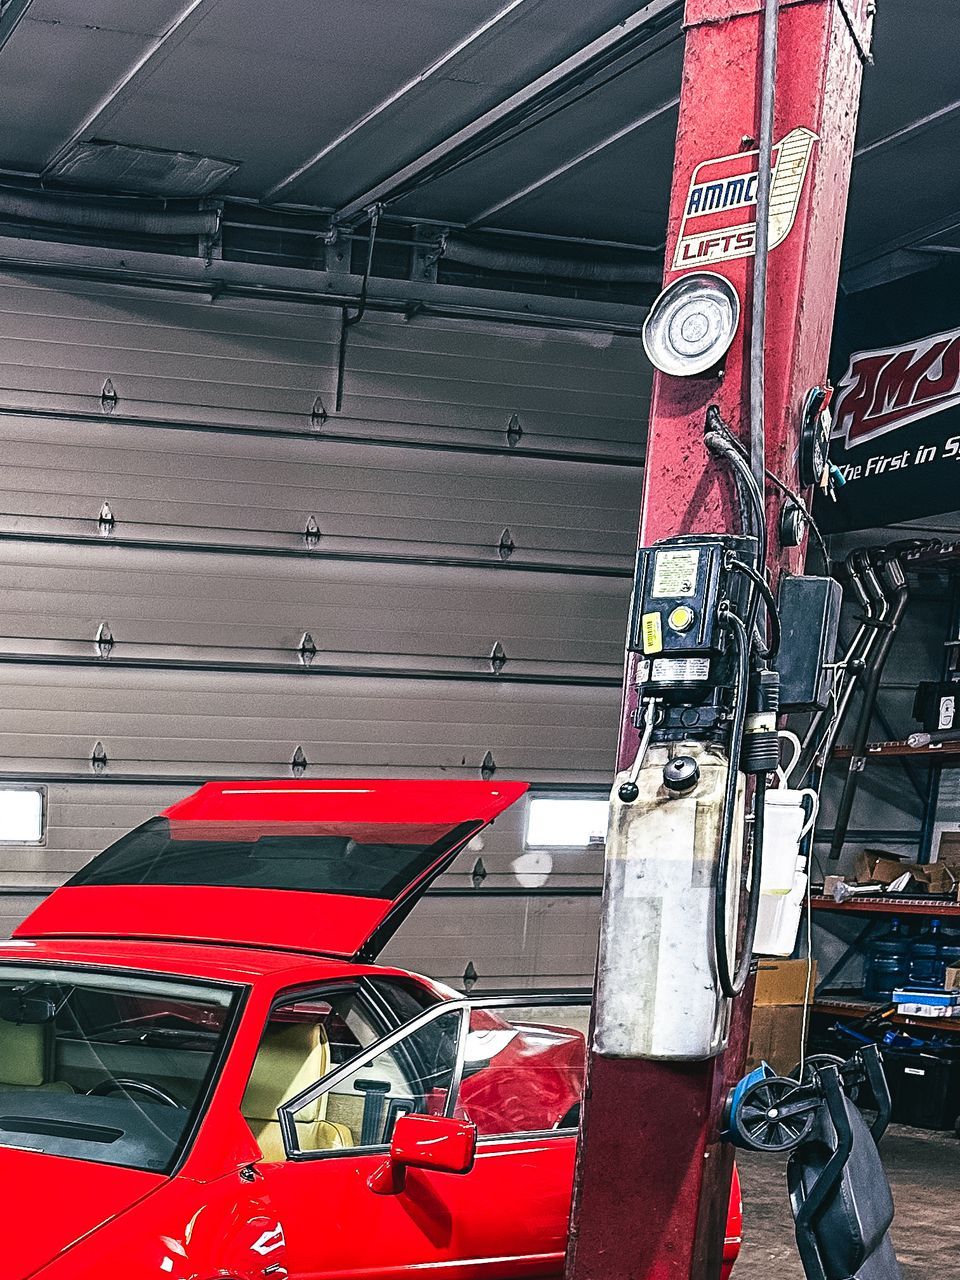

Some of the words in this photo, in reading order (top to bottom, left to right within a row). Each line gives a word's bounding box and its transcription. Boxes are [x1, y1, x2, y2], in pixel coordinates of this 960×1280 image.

[687, 174, 774, 216] AMMC
[682, 230, 756, 261] LIFTS
[864, 450, 911, 477] First
[914, 445, 937, 465] in
[942, 434, 960, 461] S
